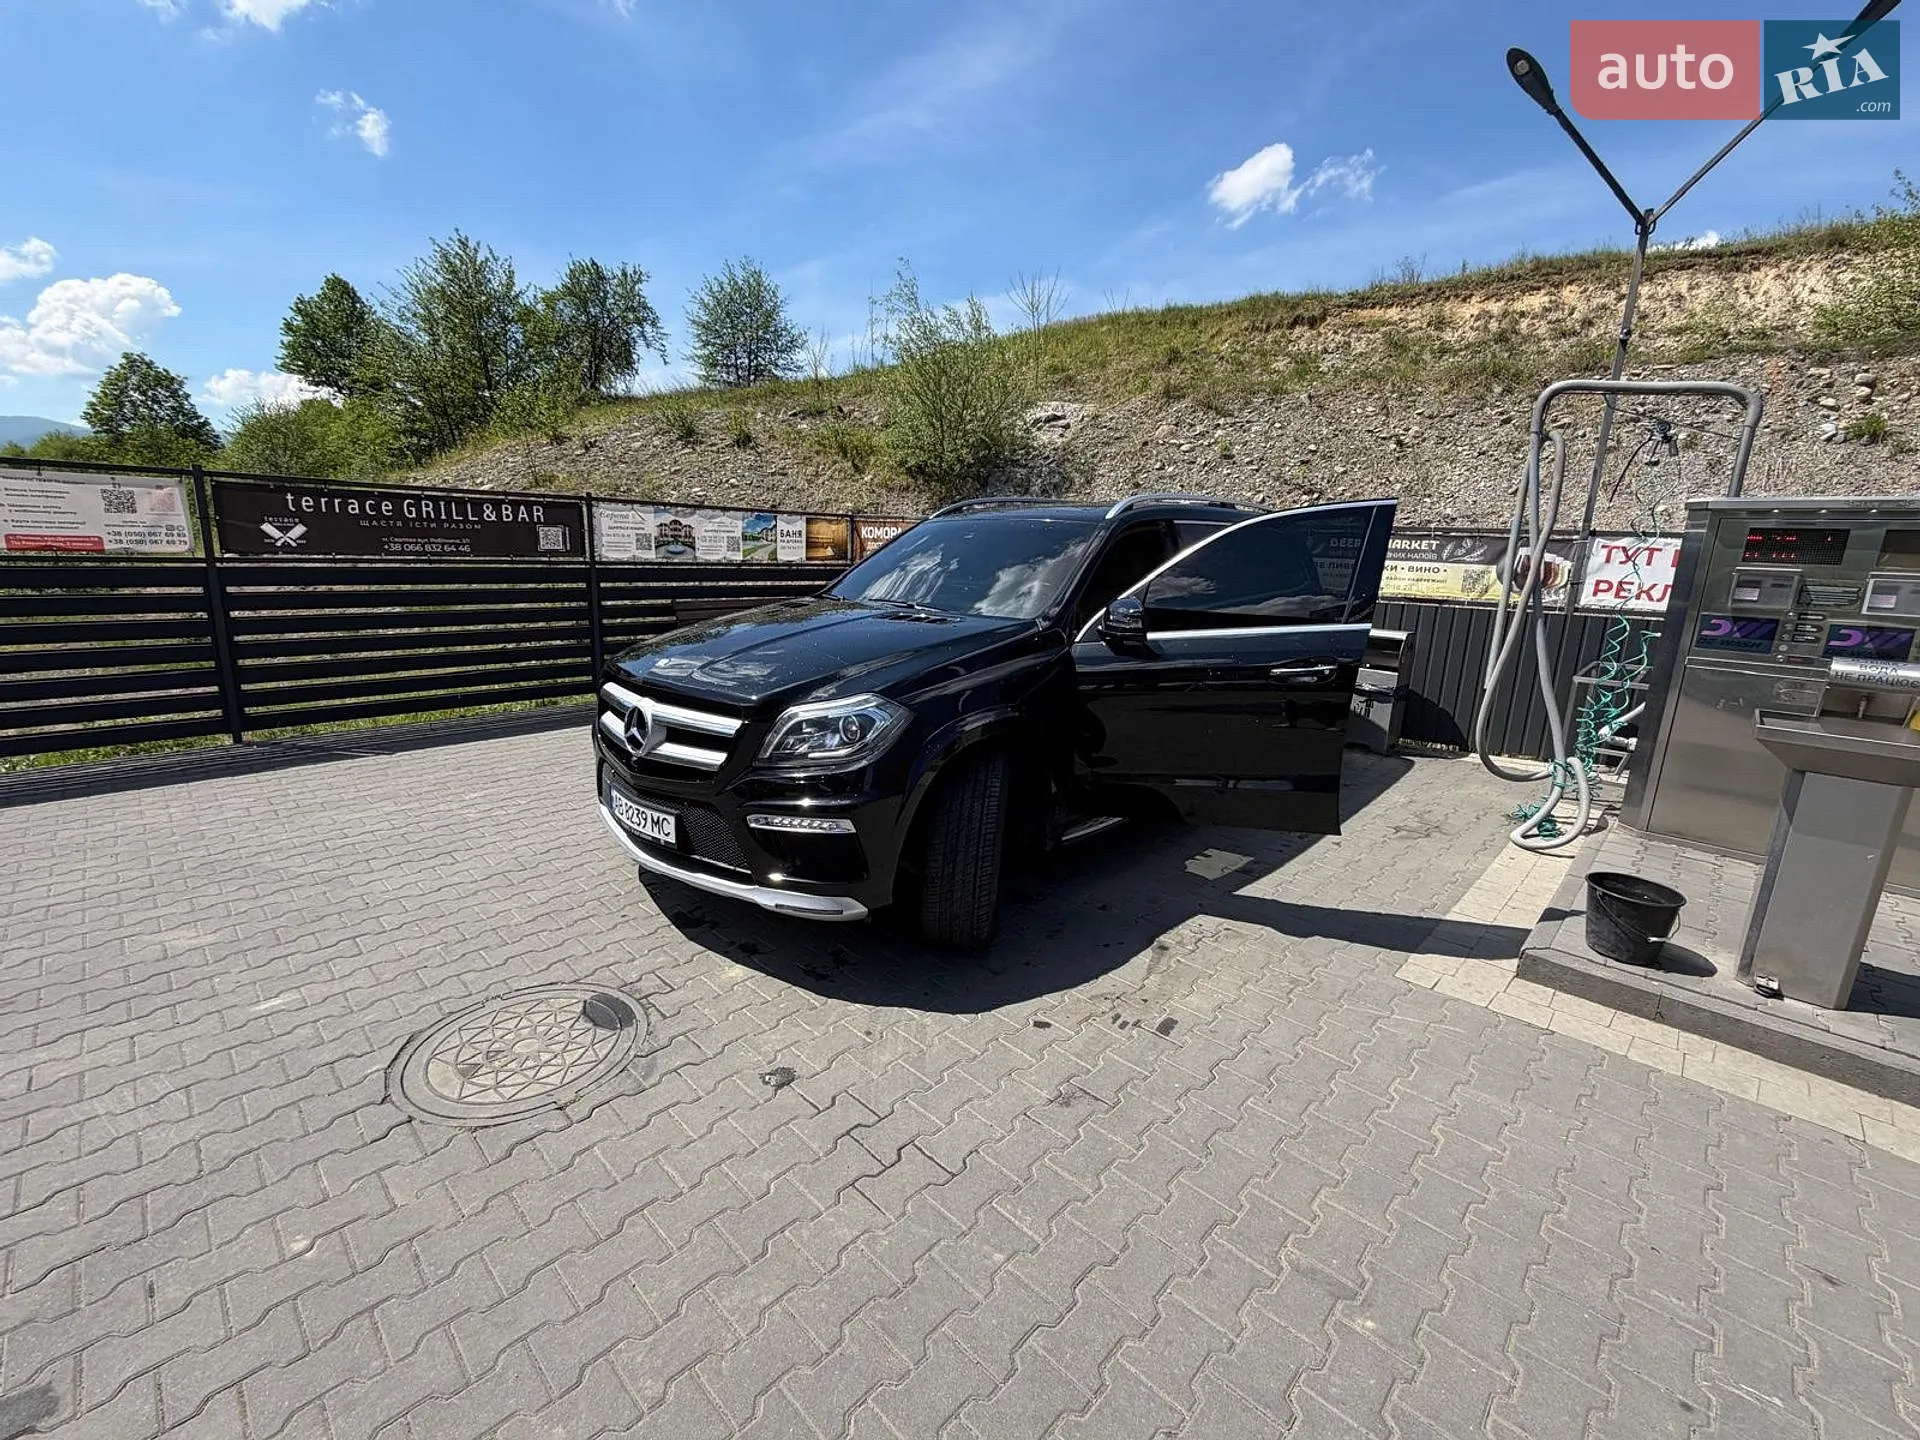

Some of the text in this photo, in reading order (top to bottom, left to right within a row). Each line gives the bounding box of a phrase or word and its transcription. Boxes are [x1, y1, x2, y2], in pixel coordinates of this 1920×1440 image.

[286, 492, 545, 523] terrace GRILL&BAR
[780, 529, 803, 538] БАНЯ
[383, 543, 402, 551] +38
[1601, 544, 1663, 567] ТУТ
[1408, 565, 1440, 574] ВИНО
[1834, 671, 1854, 682] НЕ
[625, 802, 647, 829] 8239
[651, 813, 671, 837] MC
